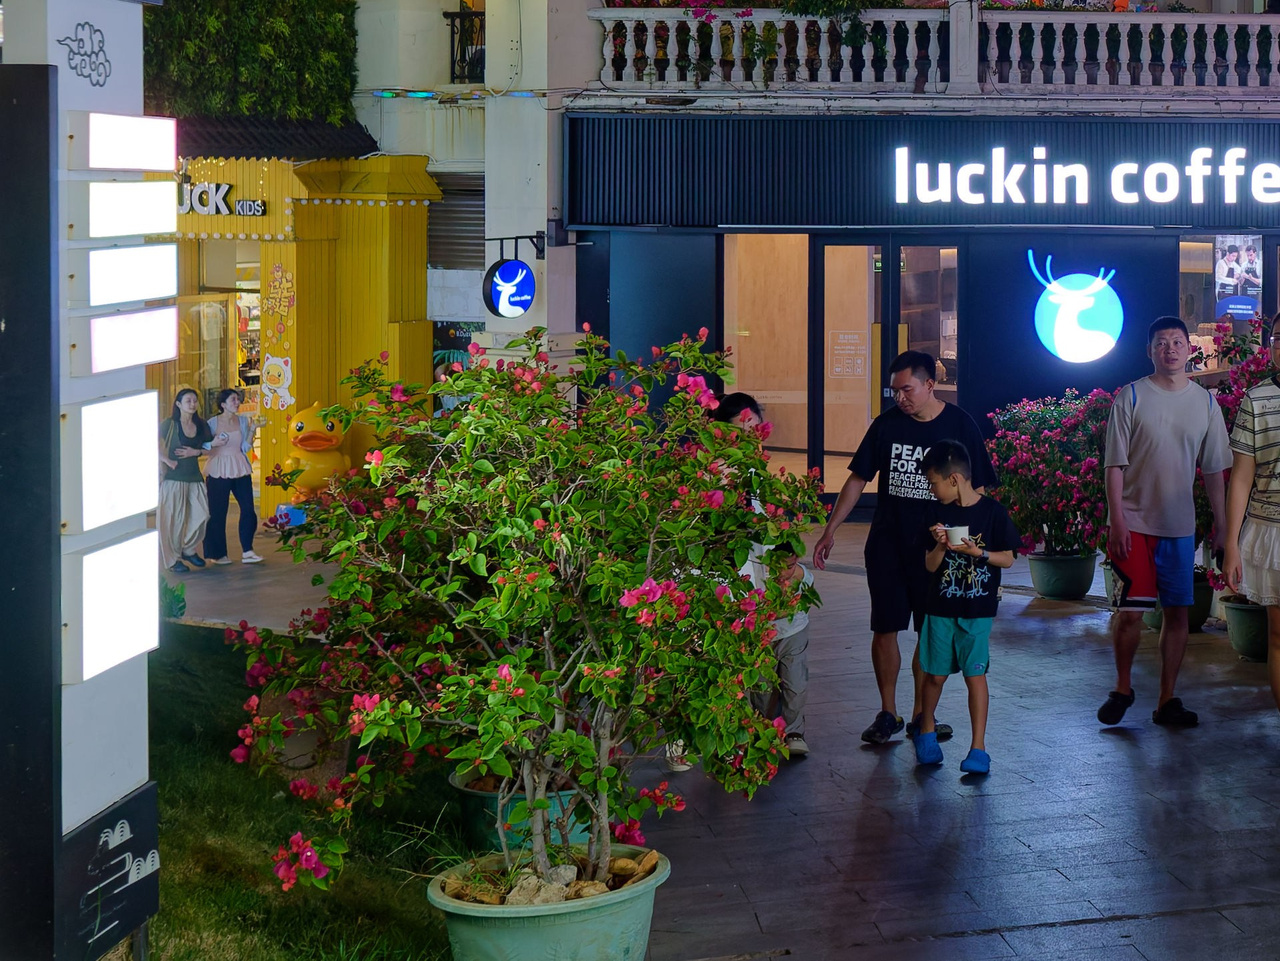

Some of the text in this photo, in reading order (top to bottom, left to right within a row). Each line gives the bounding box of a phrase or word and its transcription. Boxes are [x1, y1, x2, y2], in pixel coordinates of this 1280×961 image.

[895, 146, 1089, 204] luckin
[235, 200, 263, 215] KIDS
[890, 459, 917, 473] FOR
[889, 472, 929, 483] PEACEPE
[889, 479, 901, 487] FOR
